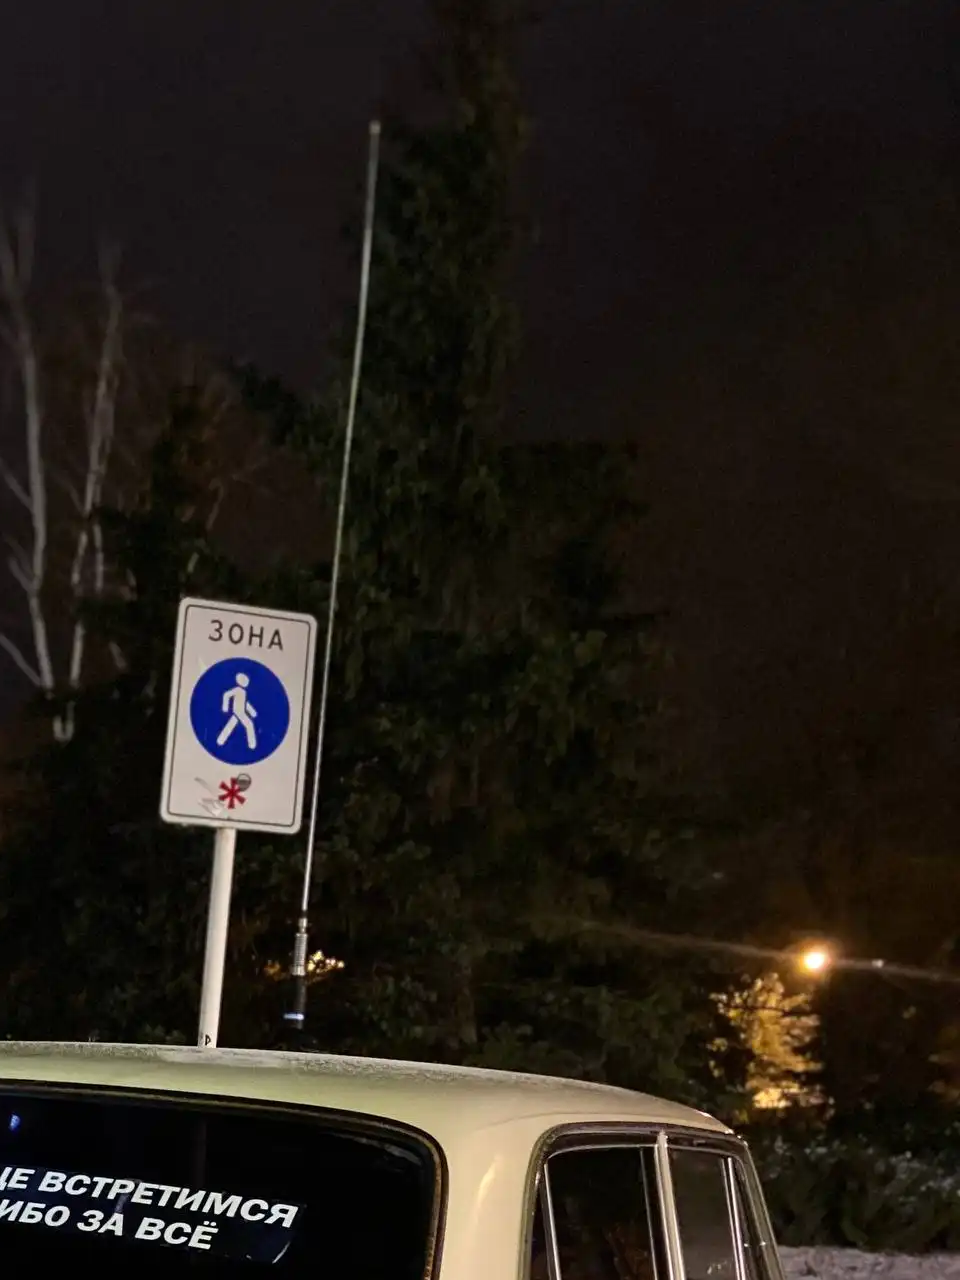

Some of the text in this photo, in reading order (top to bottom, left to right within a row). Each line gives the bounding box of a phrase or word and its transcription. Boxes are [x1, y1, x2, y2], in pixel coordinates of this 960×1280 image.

[208, 619, 284, 651] ЗОНА
[38, 1171, 299, 1228] ВСТРЕТИМСЯ
[76, 1210, 124, 1236] ЗА
[134, 1220, 219, 1250] ВСЁ
